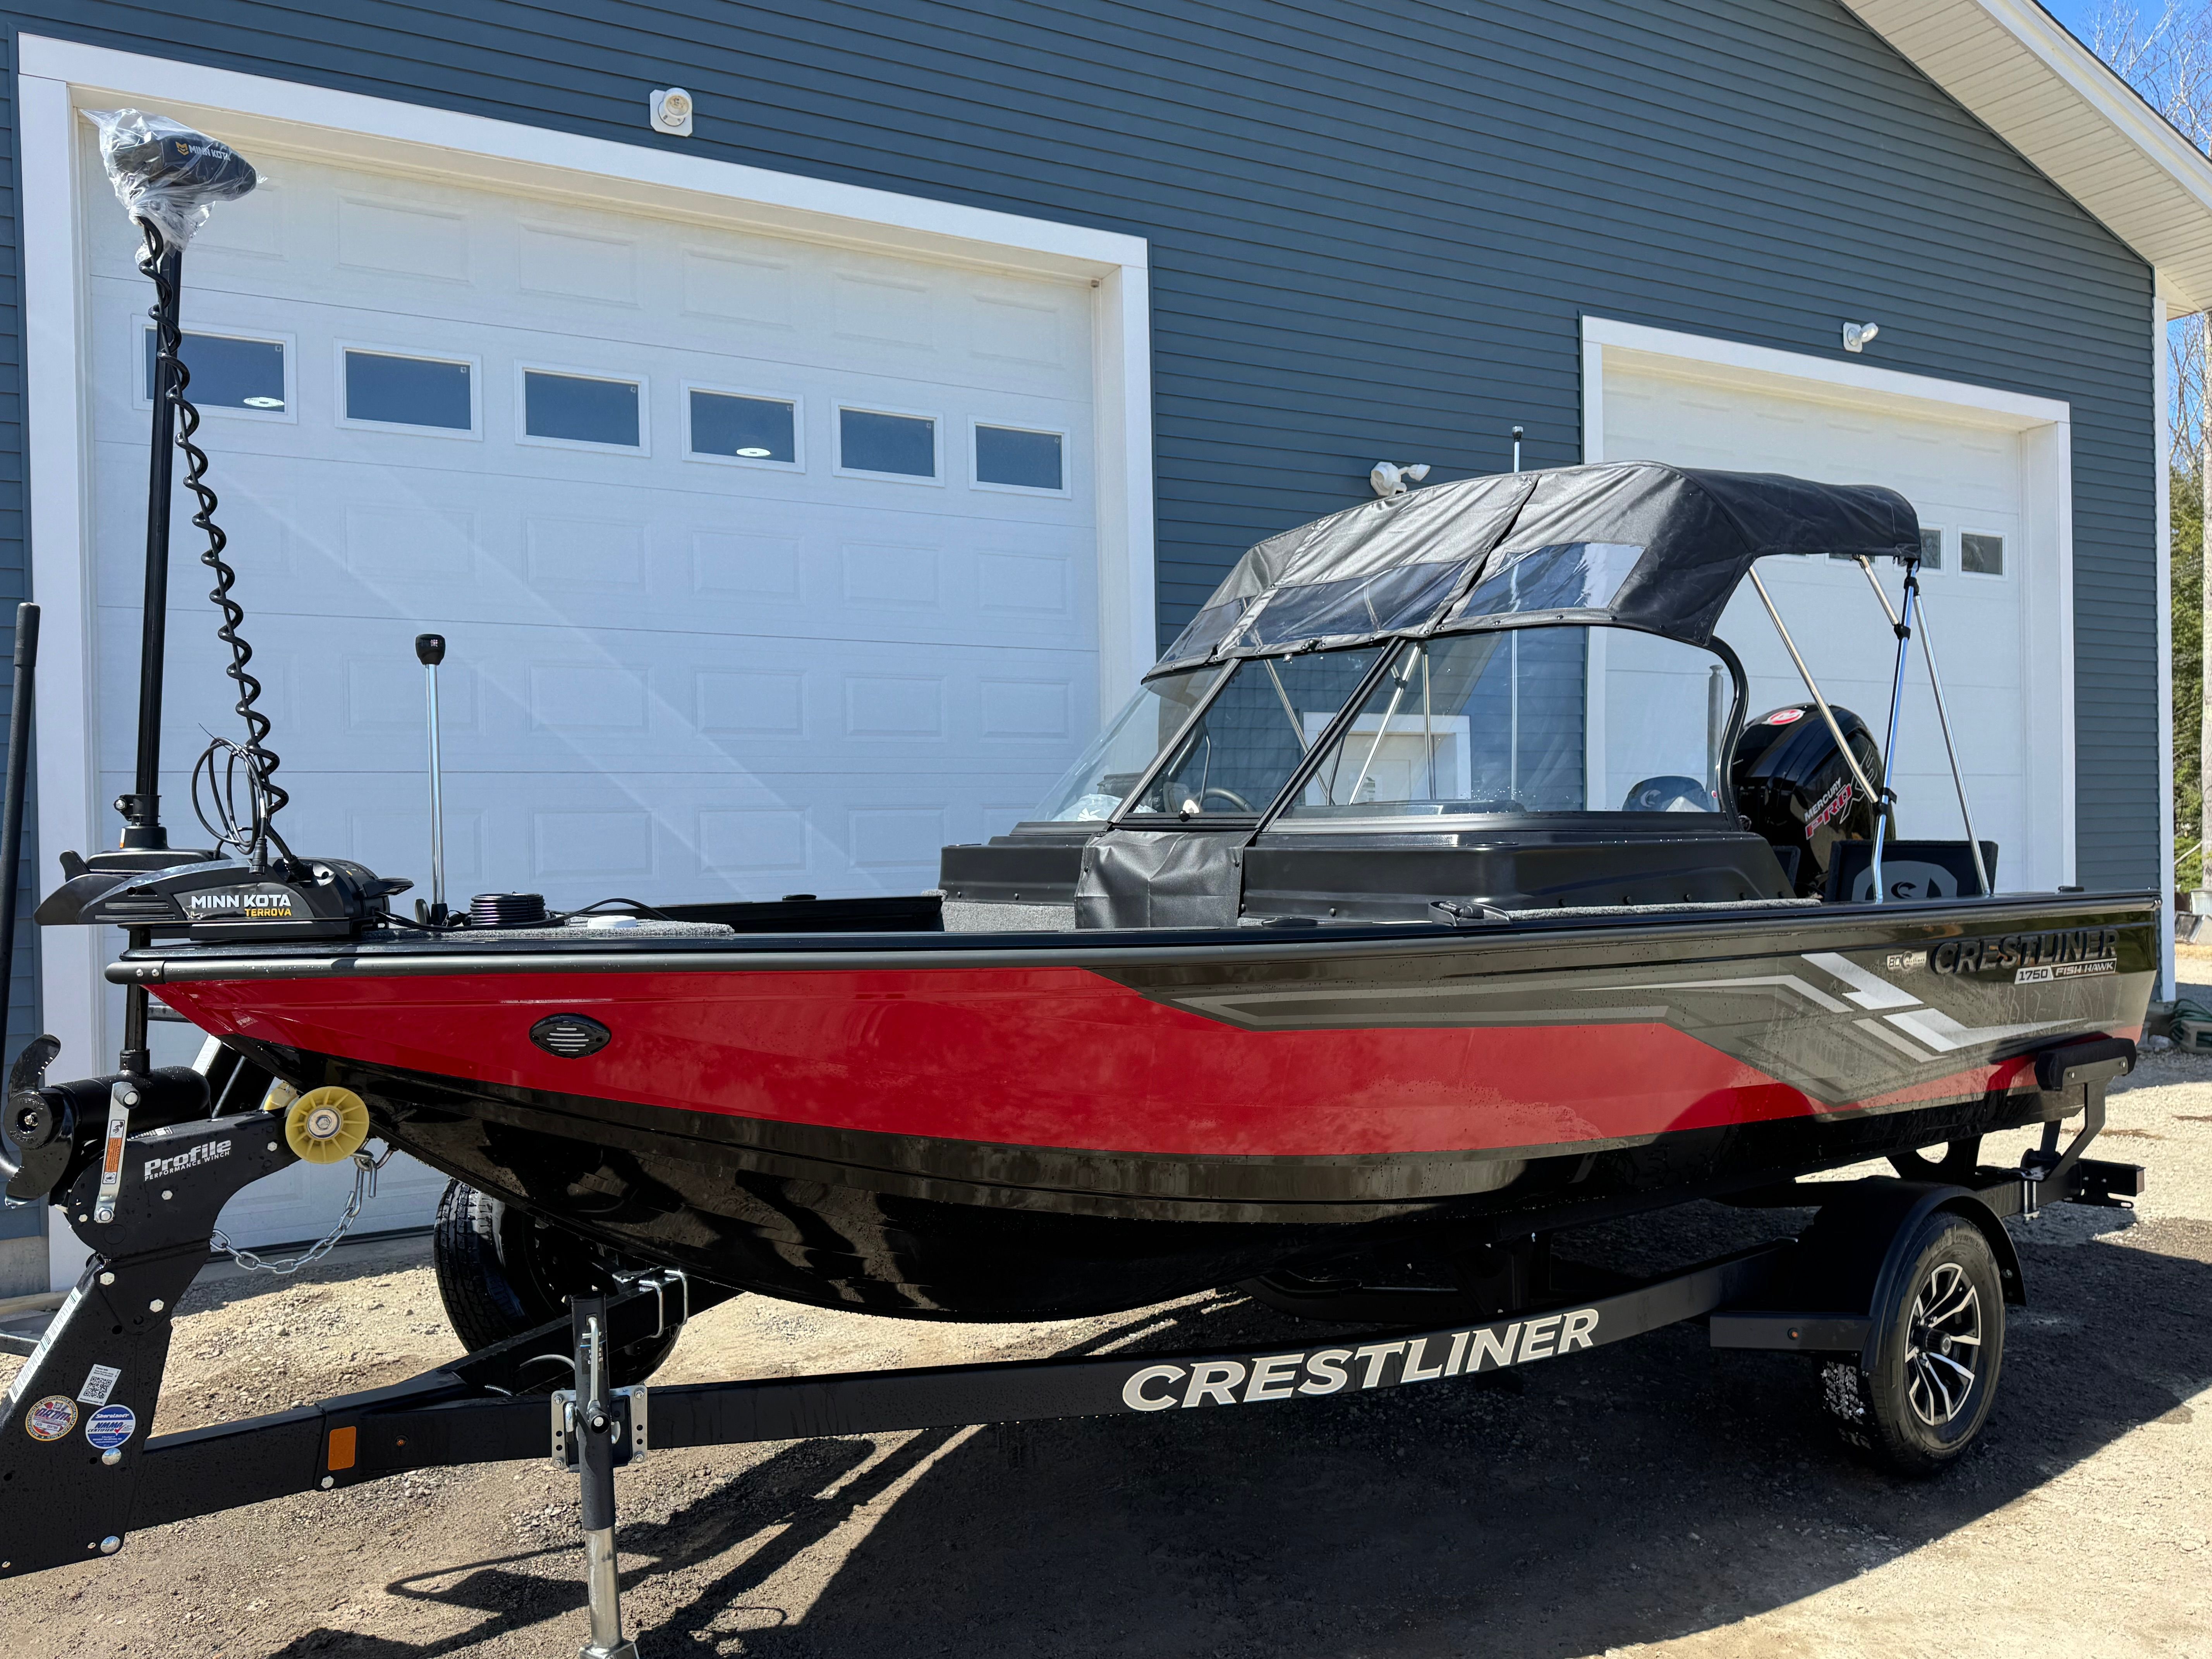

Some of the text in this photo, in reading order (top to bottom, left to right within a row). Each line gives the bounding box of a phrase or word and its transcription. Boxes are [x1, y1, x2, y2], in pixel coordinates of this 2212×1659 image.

[188, 145, 231, 161] MINN KOTA
[1804, 777, 1841, 822] MERCURY
[1805, 783, 1852, 840] PRO
[191, 894, 292, 908] MINN KOTA
[244, 908, 292, 917] TERROVA
[1932, 929, 2119, 975] CRESTLINER
[2018, 961, 2113, 981] 1750 FISH HAWK
[144, 1140, 232, 1176] Profile
[144, 1150, 230, 1182] PERFORMANCE WINCH
[1122, 1308, 1599, 1412] CRESTLINER
